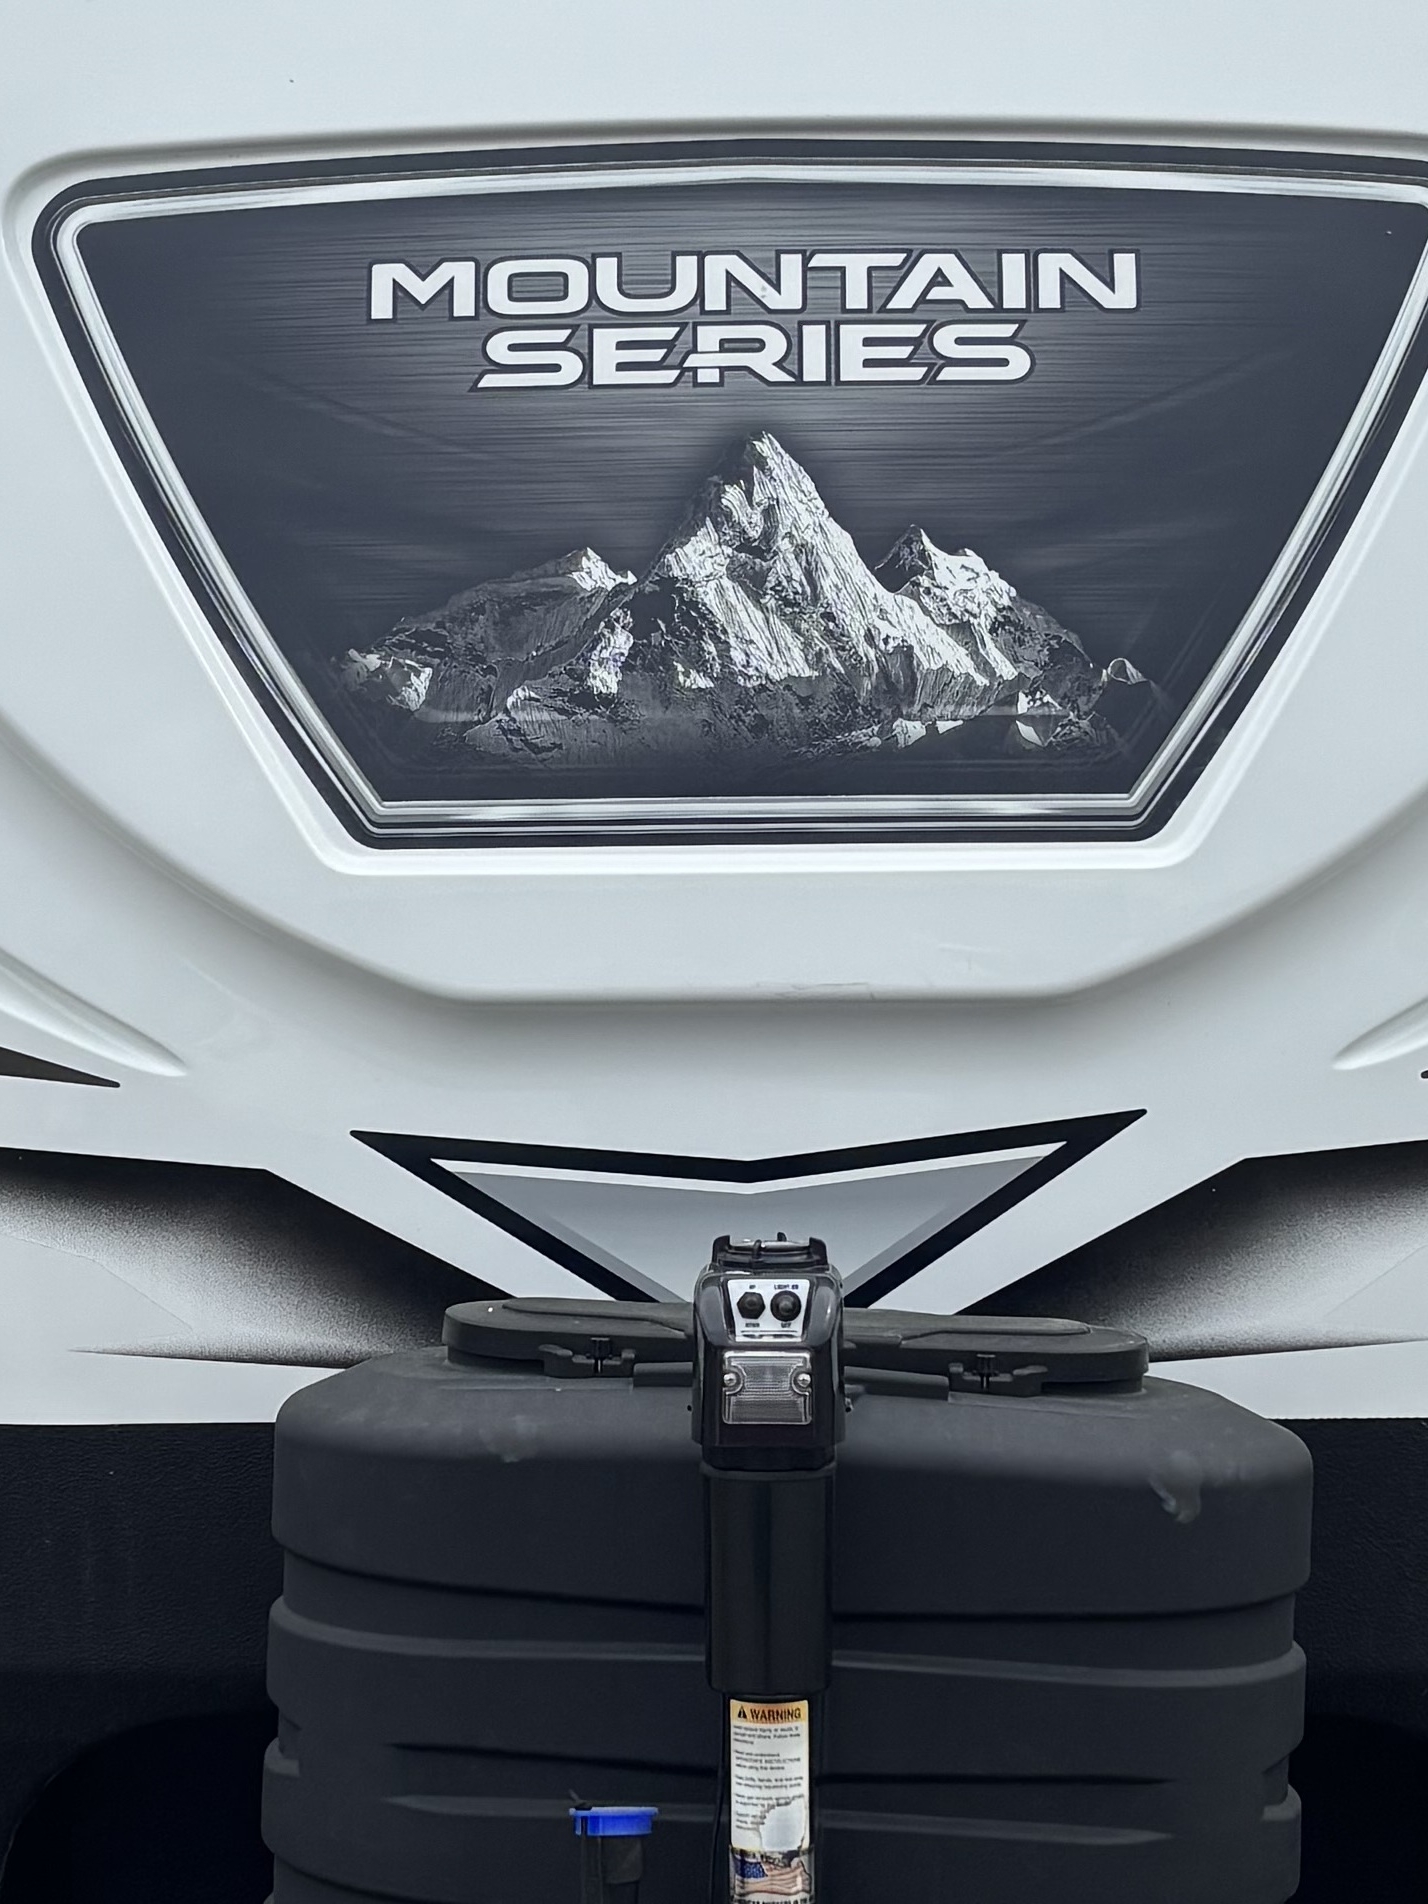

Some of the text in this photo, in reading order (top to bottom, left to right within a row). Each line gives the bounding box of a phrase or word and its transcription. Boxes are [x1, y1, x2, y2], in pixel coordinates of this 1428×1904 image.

[367, 248, 1140, 323] MOUNTAIN
[468, 319, 1036, 392] SERIES
[749, 1707, 802, 1721] WARNING
